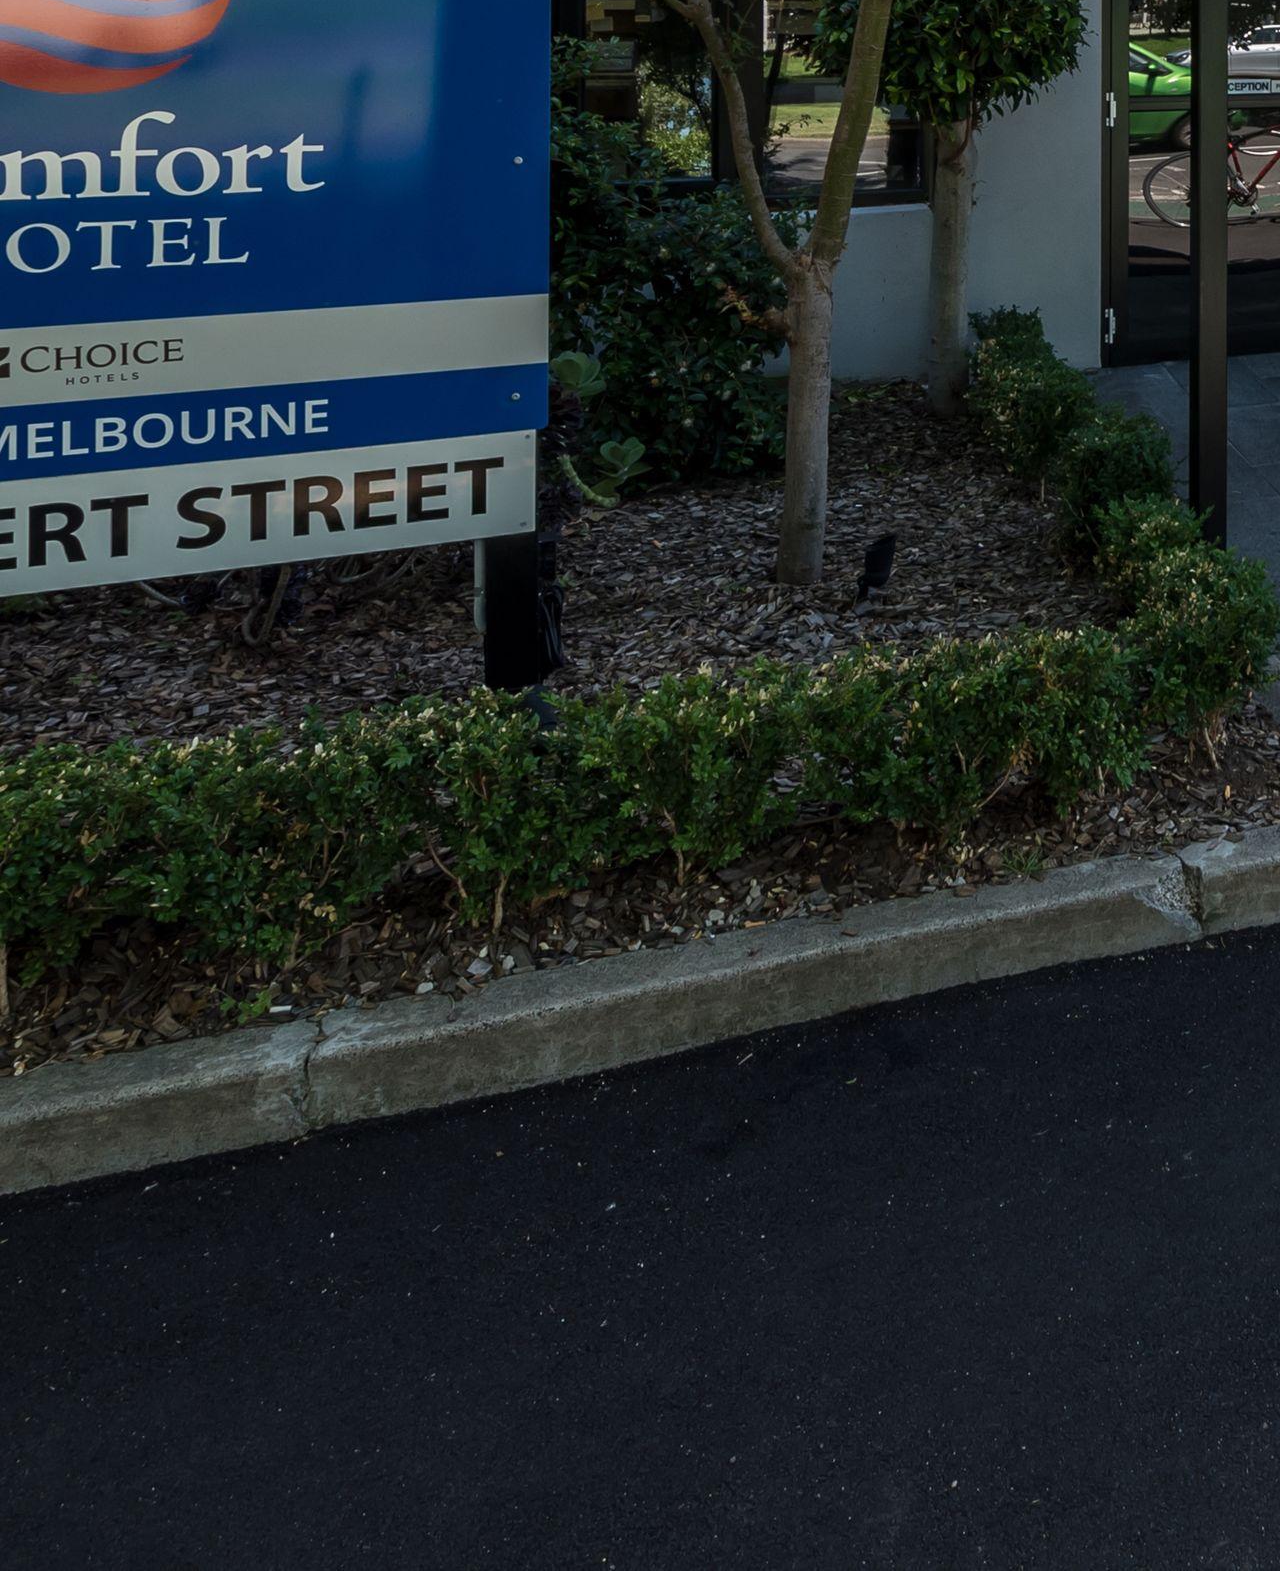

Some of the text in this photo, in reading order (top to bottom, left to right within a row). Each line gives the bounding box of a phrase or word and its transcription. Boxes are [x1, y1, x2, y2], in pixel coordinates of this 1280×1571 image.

[0, 110, 326, 201] mfort
[5, 216, 250, 274] OTEL
[20, 338, 185, 374] CHOICE
[65, 371, 140, 386] HOTELS
[175, 456, 505, 550] STREET
